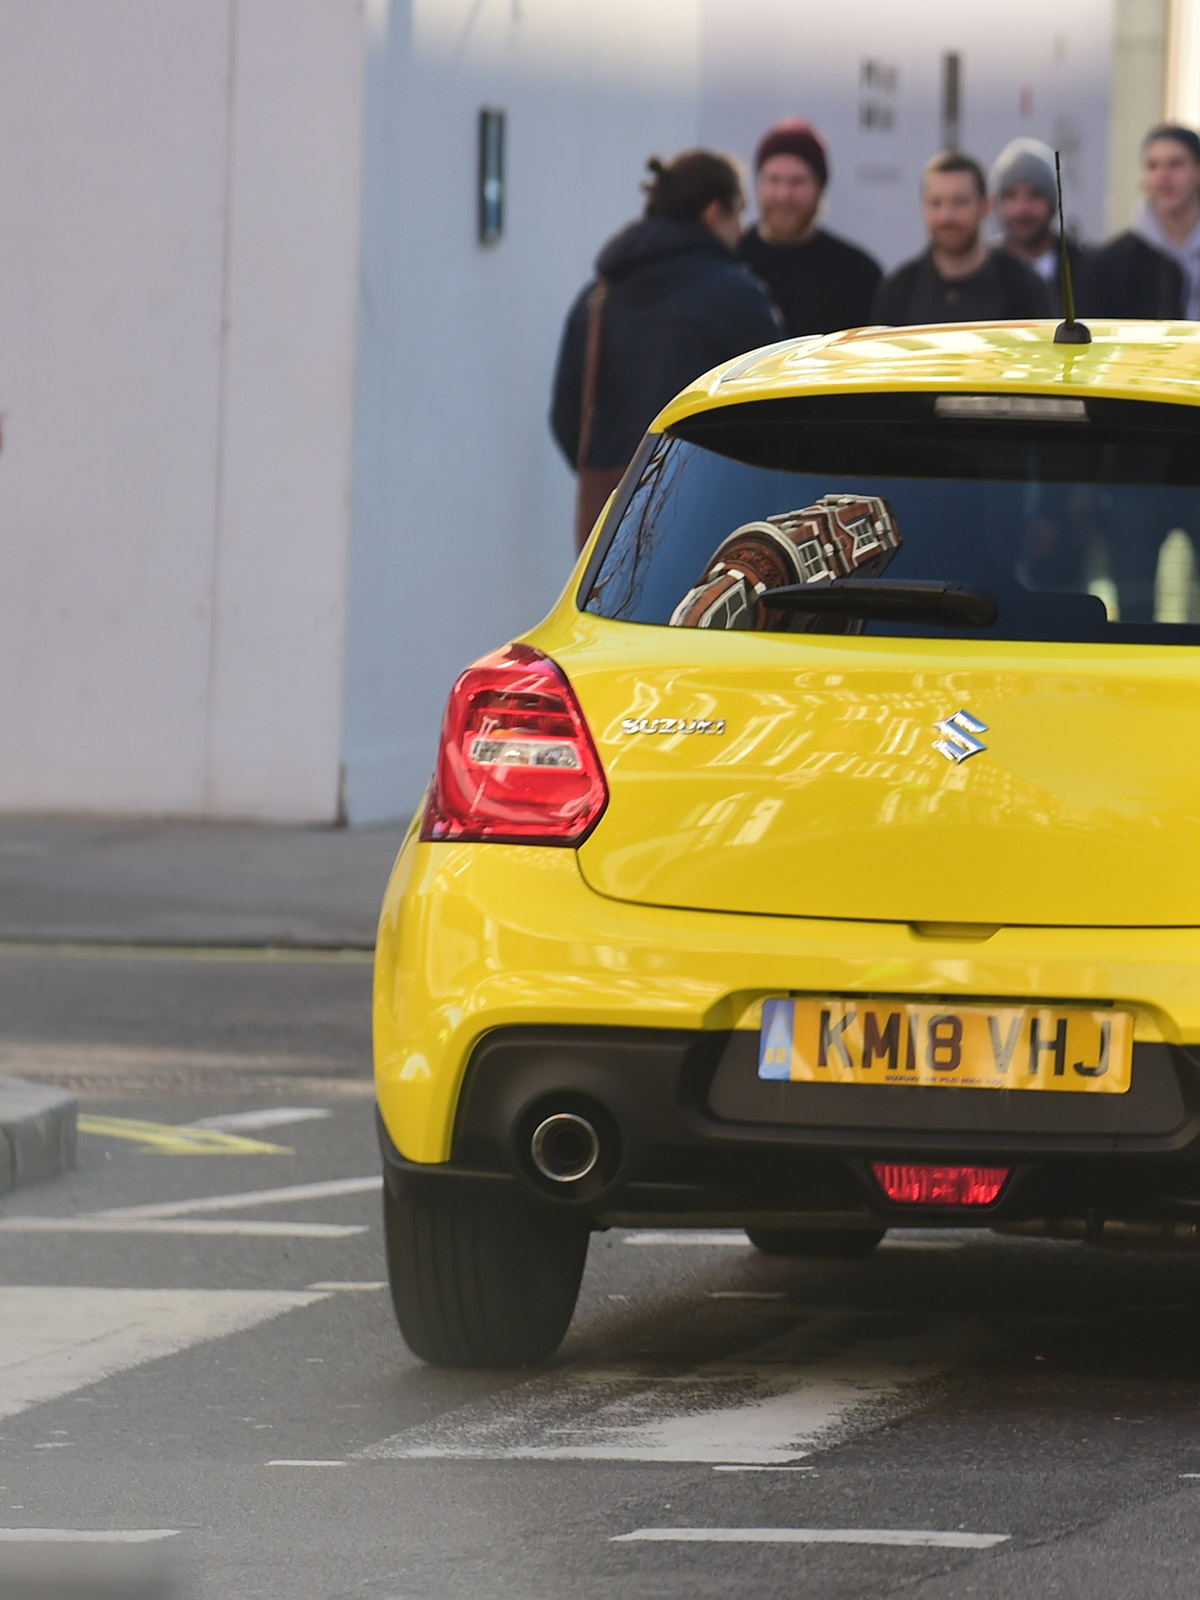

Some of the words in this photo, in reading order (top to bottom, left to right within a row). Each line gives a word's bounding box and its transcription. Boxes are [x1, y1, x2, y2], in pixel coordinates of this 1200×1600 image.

[621, 718, 726, 735] SUZUKI
[817, 1009, 963, 1072] KM18
[987, 1015, 1112, 1077] VHJ
